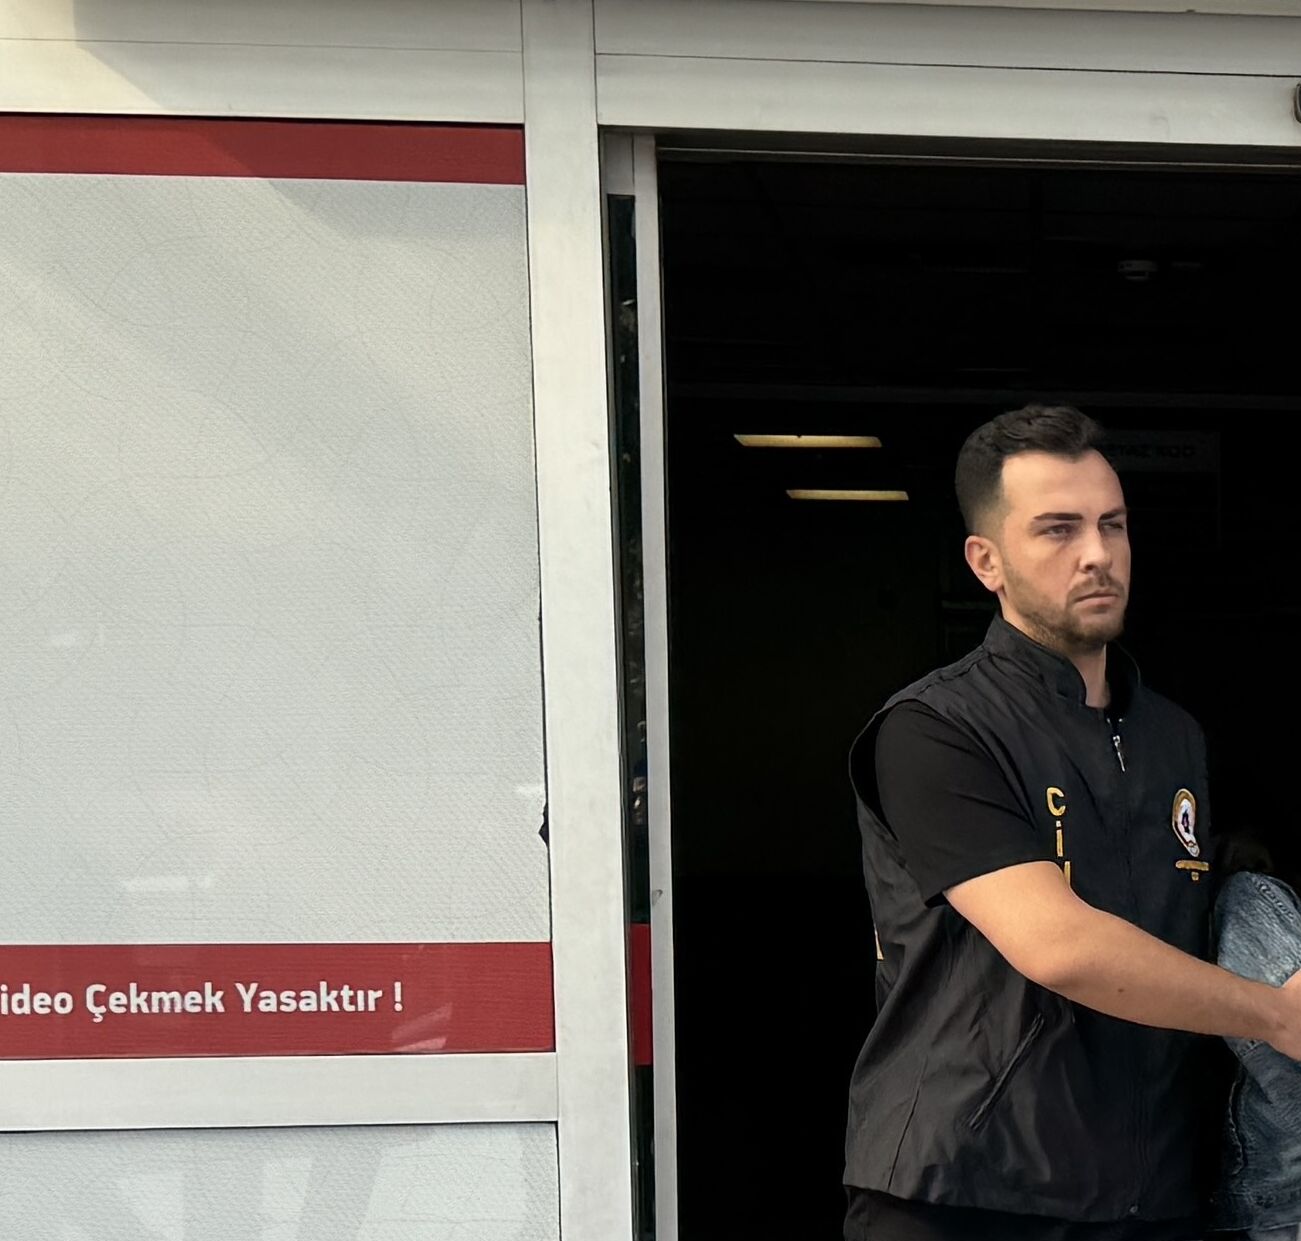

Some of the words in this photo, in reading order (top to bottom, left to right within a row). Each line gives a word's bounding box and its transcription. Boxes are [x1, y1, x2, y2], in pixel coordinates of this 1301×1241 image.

[0, 983, 74, 1015] ideo
[86, 982, 225, 1023] Çekmek
[235, 981, 382, 1013] Yasaktır
